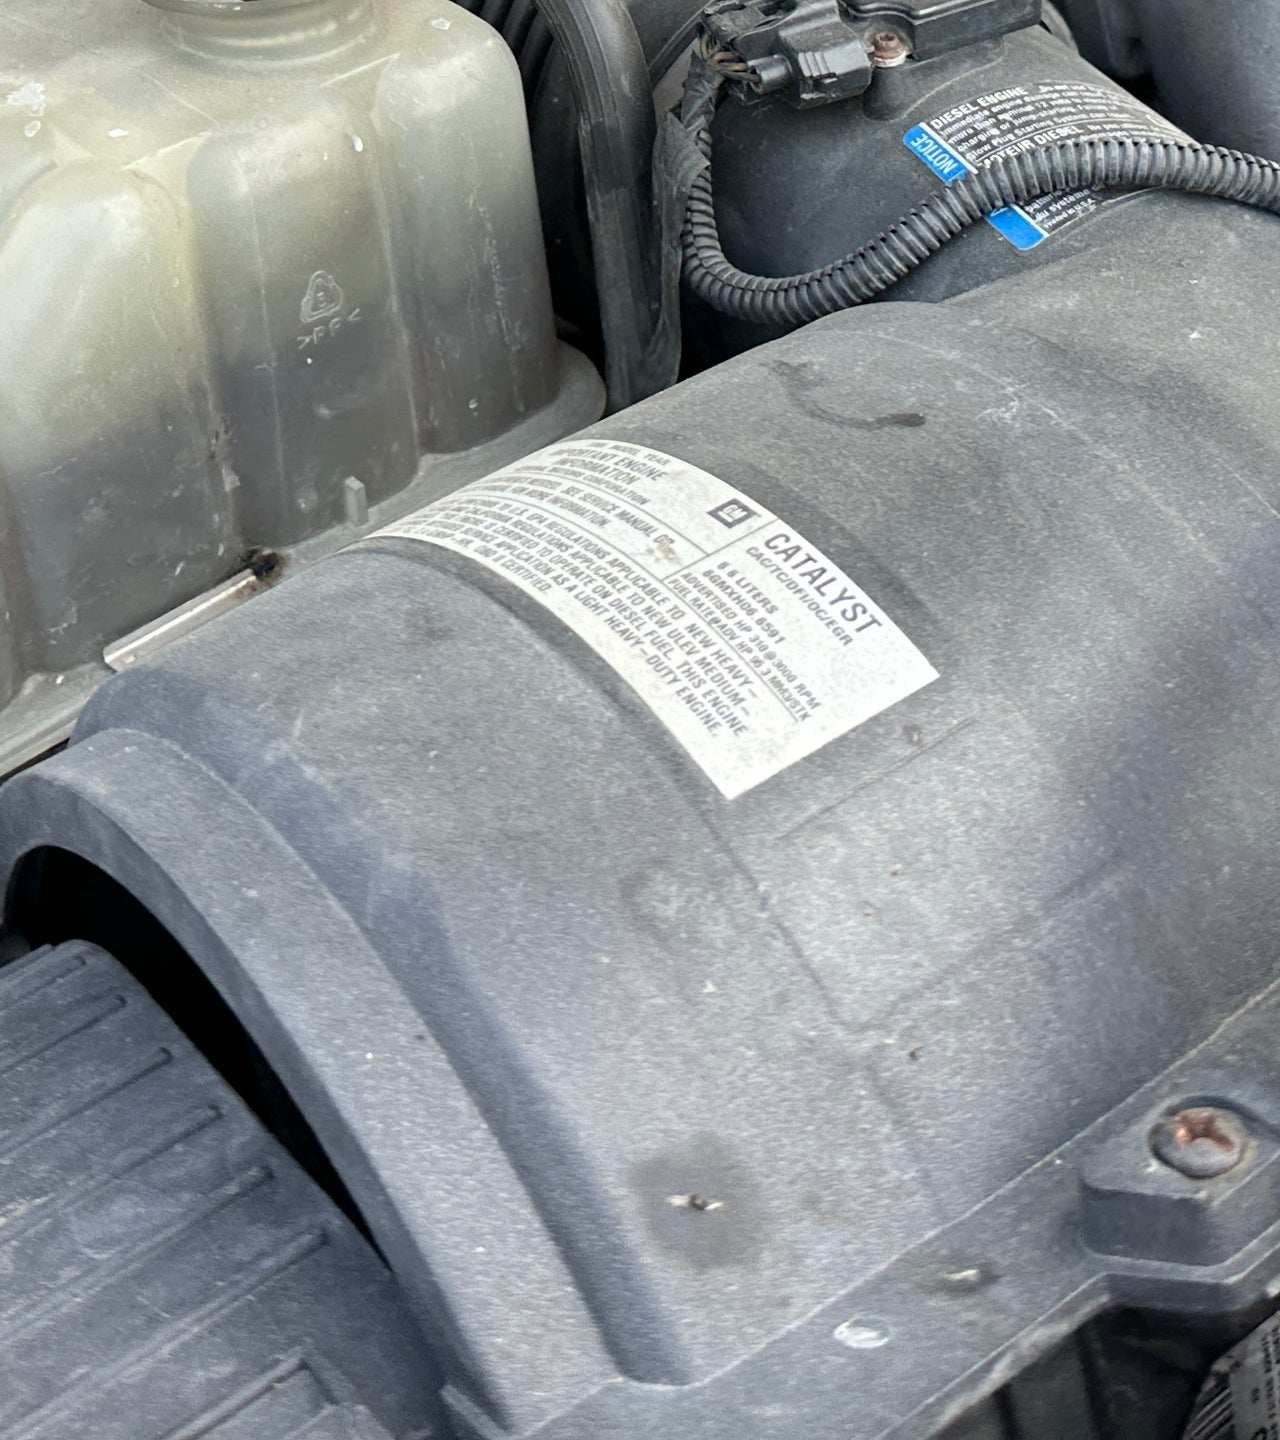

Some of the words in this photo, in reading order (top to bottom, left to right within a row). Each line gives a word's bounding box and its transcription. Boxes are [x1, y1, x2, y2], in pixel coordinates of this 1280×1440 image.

[930, 103, 979, 129] DIESEL
[977, 87, 1028, 107] ENGINE
[939, 110, 990, 135] Immediate
[948, 128, 974, 144] more
[973, 117, 997, 130] than
[958, 128, 1000, 151] charging
[991, 133, 1015, 147] Plug
[1014, 120, 1055, 136] Starting
[1033, 125, 1084, 144] DIESEL
[910, 133, 958, 174] NOTICE
[613, 457, 669, 481] ENGINE
[580, 492, 620, 514] SERVICE
[615, 509, 657, 538] MANUAL
[494, 540, 556, 576] APPLICATION
[550, 573, 570, 586] AS
[573, 590, 611, 616] LIGHT
[510, 519, 573, 553] REGULATIONS
[568, 551, 632, 595] APPLICABLE
[626, 591, 646, 606] TO
[639, 604, 672, 629] NEW
[666, 628, 700, 657] ULEV
[526, 512, 549, 523] EPA
[543, 520, 611, 560] REGULATIONS
[606, 558, 670, 606] APPLICABLE
[666, 604, 686, 620] TO
[684, 622, 717, 649] NEW
[736, 577, 778, 615] LITERS
[746, 547, 853, 646] CAC/TC/DFI/OC/EGR
[765, 533, 883, 633] CATALYST
[491, 526, 540, 549] CERTIFIED
[536, 547, 554, 557] TO
[549, 555, 598, 587] OPERATE
[591, 584, 613, 600] ON
[608, 598, 648, 632] DIESEL
[675, 659, 707, 690] THIS
[701, 688, 749, 736] ENGINE
[668, 578, 693, 599] FUEL
[735, 641, 754, 655] HP
[680, 572, 738, 620] ADVERTISED
[734, 619, 753, 633] HP
[793, 683, 822, 710] RPM
